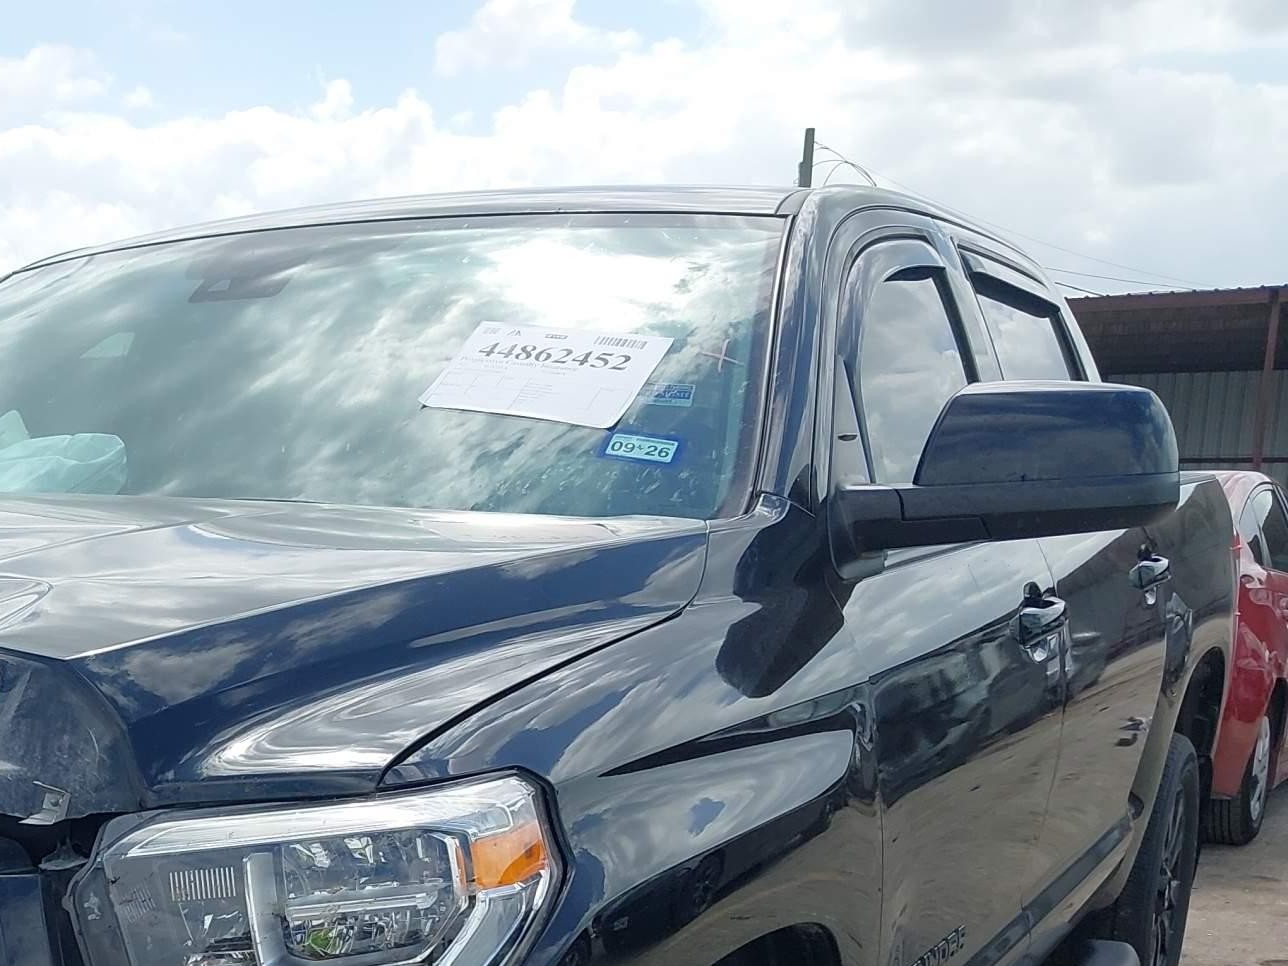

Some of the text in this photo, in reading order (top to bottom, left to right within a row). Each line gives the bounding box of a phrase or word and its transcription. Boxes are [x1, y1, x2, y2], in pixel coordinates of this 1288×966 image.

[479, 342, 632, 371] 44862452
[610, 441, 672, 459] 09 26
